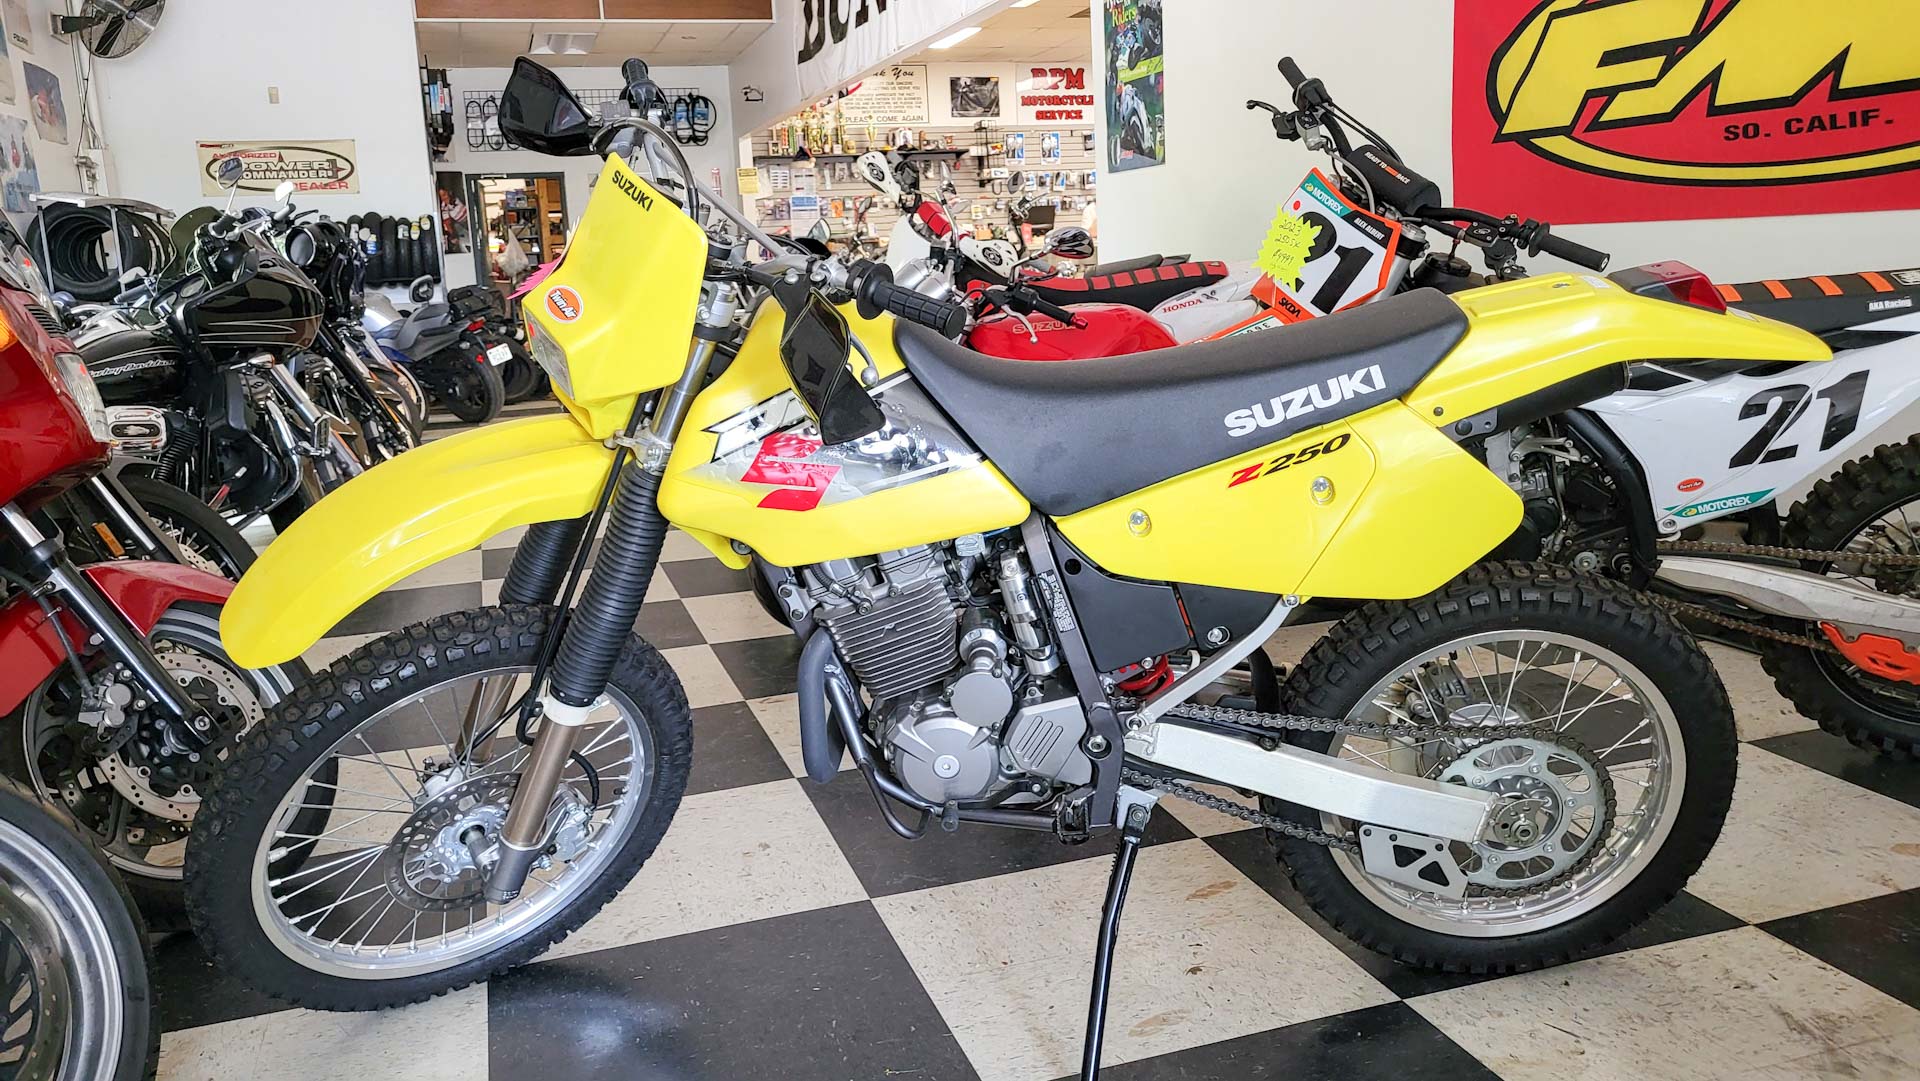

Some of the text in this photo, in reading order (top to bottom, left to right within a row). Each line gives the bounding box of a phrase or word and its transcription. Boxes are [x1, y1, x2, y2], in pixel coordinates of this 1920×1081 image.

[891, 67, 914, 80] You
[1031, 68, 1085, 90] RPM
[1036, 110, 1083, 120] SERVICE
[1723, 108, 1894, 142] SO. CALIF.
[240, 170, 328, 180] OMMANDER
[1364, 152, 1410, 184] READY TO RACE
[611, 170, 654, 212] SUZUKI
[1311, 187, 1344, 214] MOTOREX
[1354, 218, 1385, 240] ALEX ALBERT
[549, 290, 578, 318] Twin Air
[1162, 299, 1202, 314] HONDA
[1868, 298, 1912, 312] AKA Racing
[1012, 320, 1077, 334] SUZU
[1224, 364, 1387, 437] SUZUKI
[1728, 369, 1870, 469] 21
[1697, 496, 1752, 514] MOTOREX
